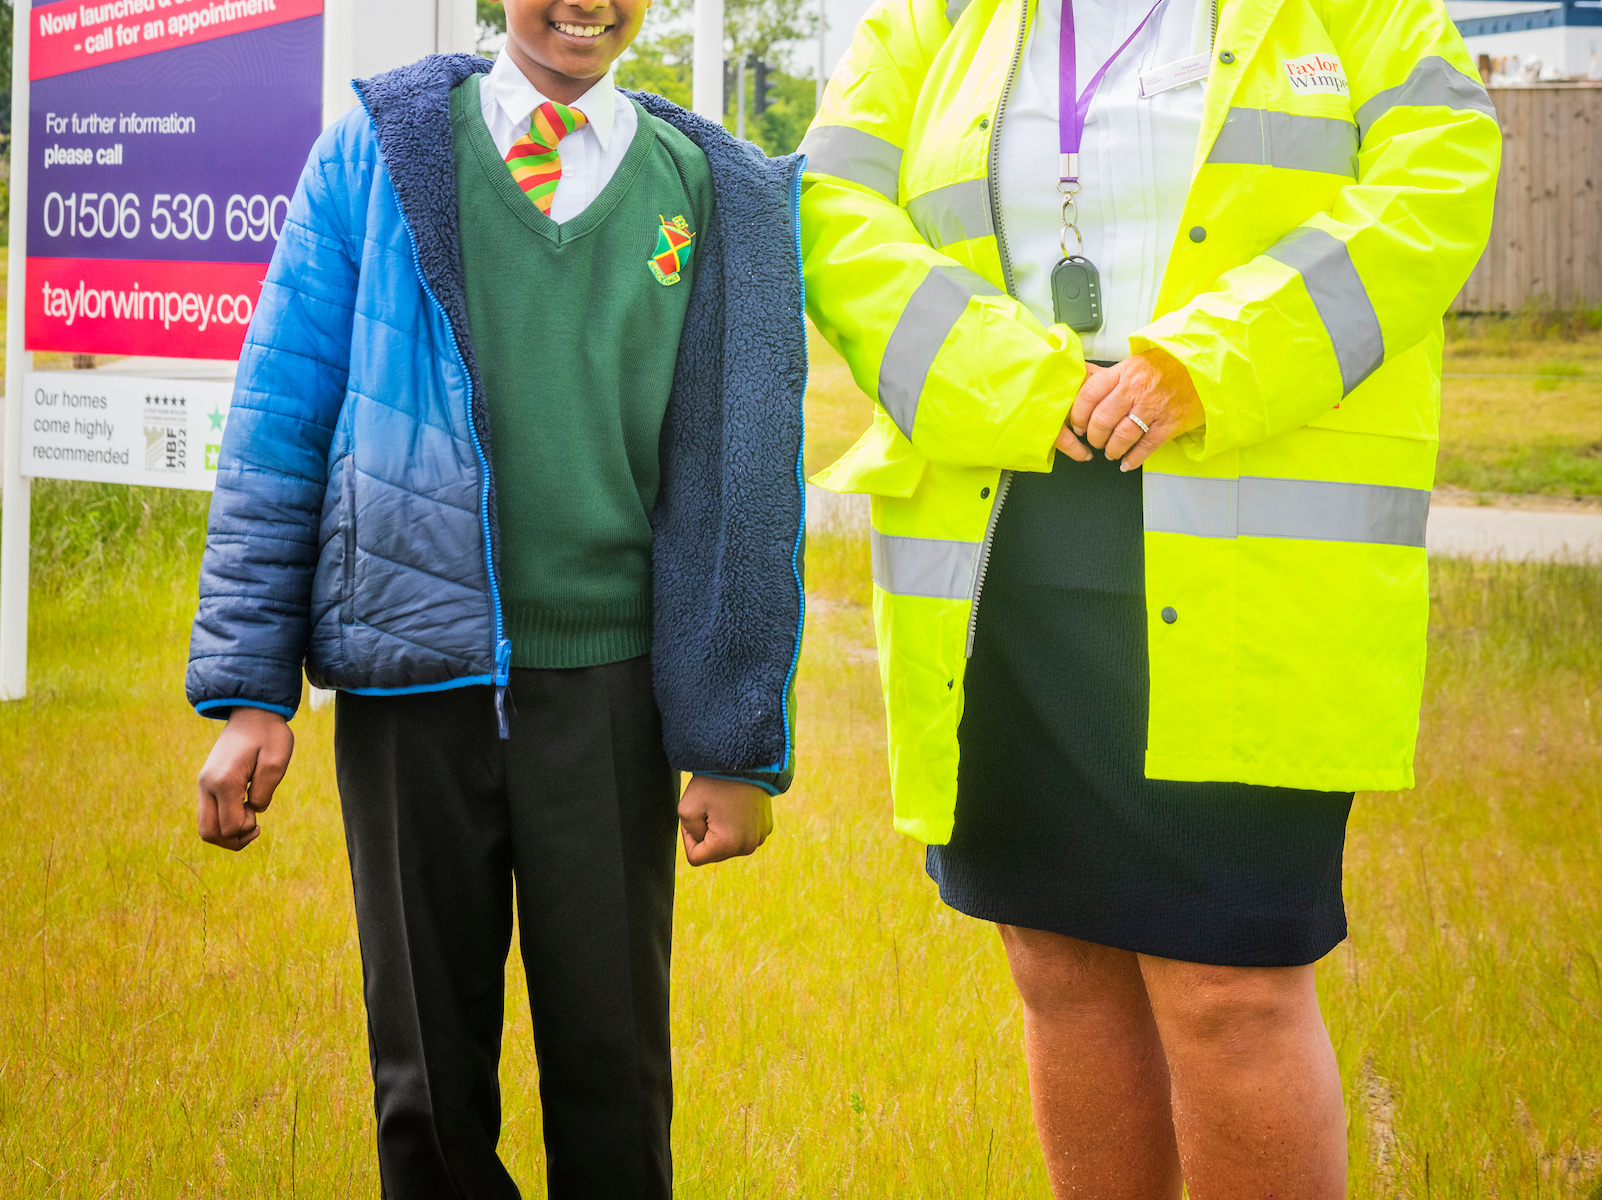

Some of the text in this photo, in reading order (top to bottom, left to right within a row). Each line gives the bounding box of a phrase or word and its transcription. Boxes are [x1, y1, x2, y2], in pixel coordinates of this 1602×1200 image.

[39, 11, 78, 37] Now
[84, 26, 113, 54] call
[115, 22, 141, 47] for
[143, 19, 164, 40] an
[1283, 56, 1338, 76] Taylor
[46, 112, 196, 134] For further information
[44, 143, 123, 169] please call
[43, 191, 290, 242] 01506 530 690
[42, 280, 252, 331] taylorwimpey.co
[35, 388, 107, 409] Our homes
[33, 417, 114, 441] come highly
[33, 446, 129, 465] recommended
[166, 428, 177, 468] HBF
[178, 429, 187, 468] 2022
